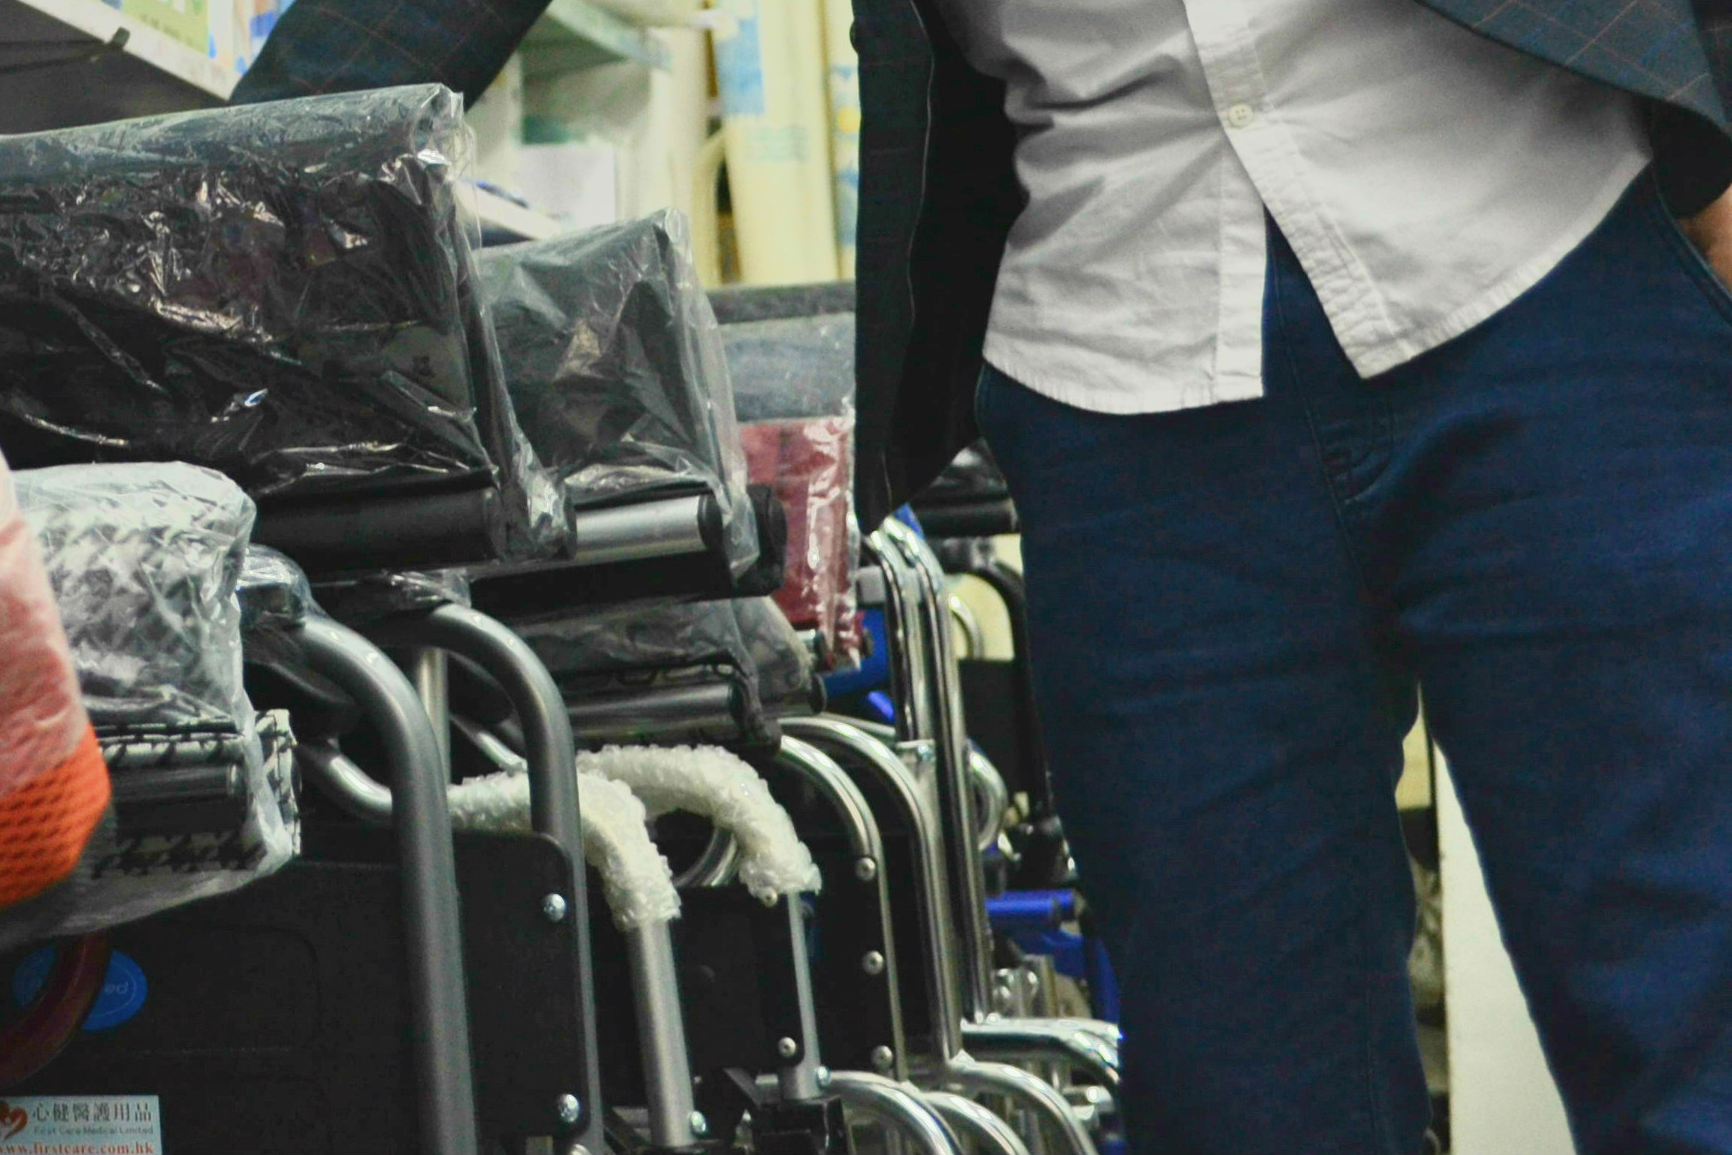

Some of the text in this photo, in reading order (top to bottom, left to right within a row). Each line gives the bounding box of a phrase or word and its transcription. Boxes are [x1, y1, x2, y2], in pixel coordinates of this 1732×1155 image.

[32, 1102, 152, 1123] 心健醫護用品
